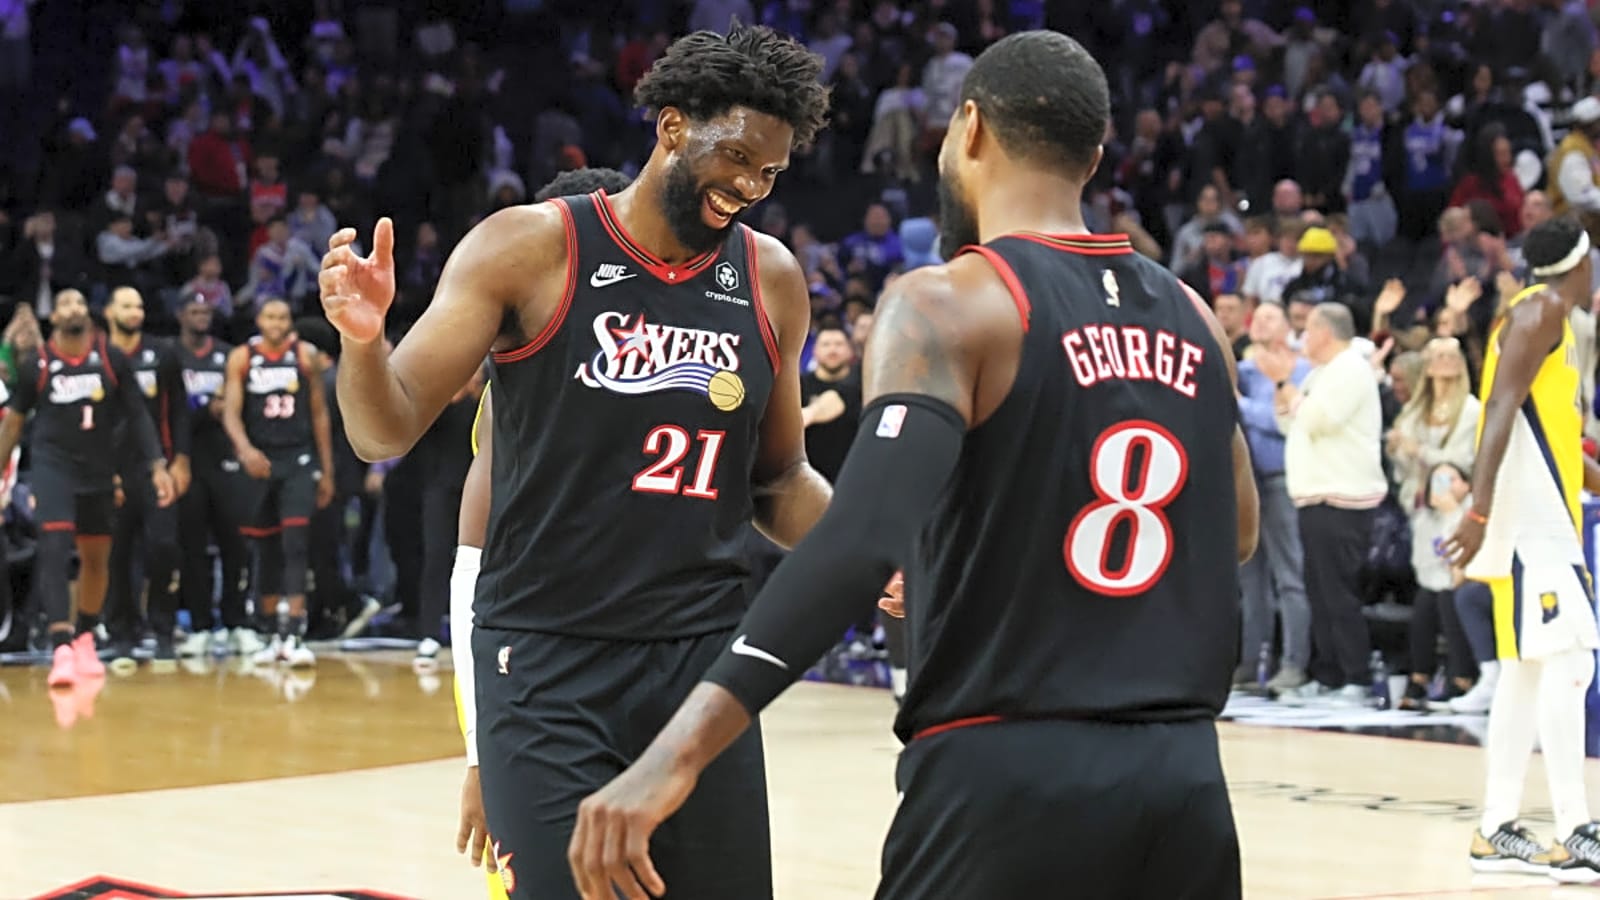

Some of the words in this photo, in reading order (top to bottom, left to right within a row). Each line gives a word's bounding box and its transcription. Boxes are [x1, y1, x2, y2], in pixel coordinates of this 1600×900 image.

[596, 263, 627, 278] NIKE
[705, 290, 749, 306] crypto.com
[577, 311, 741, 386] SIXERS
[1062, 324, 1204, 398] GEORGE
[631, 424, 727, 500] 21
[1064, 419, 1189, 597] 8
